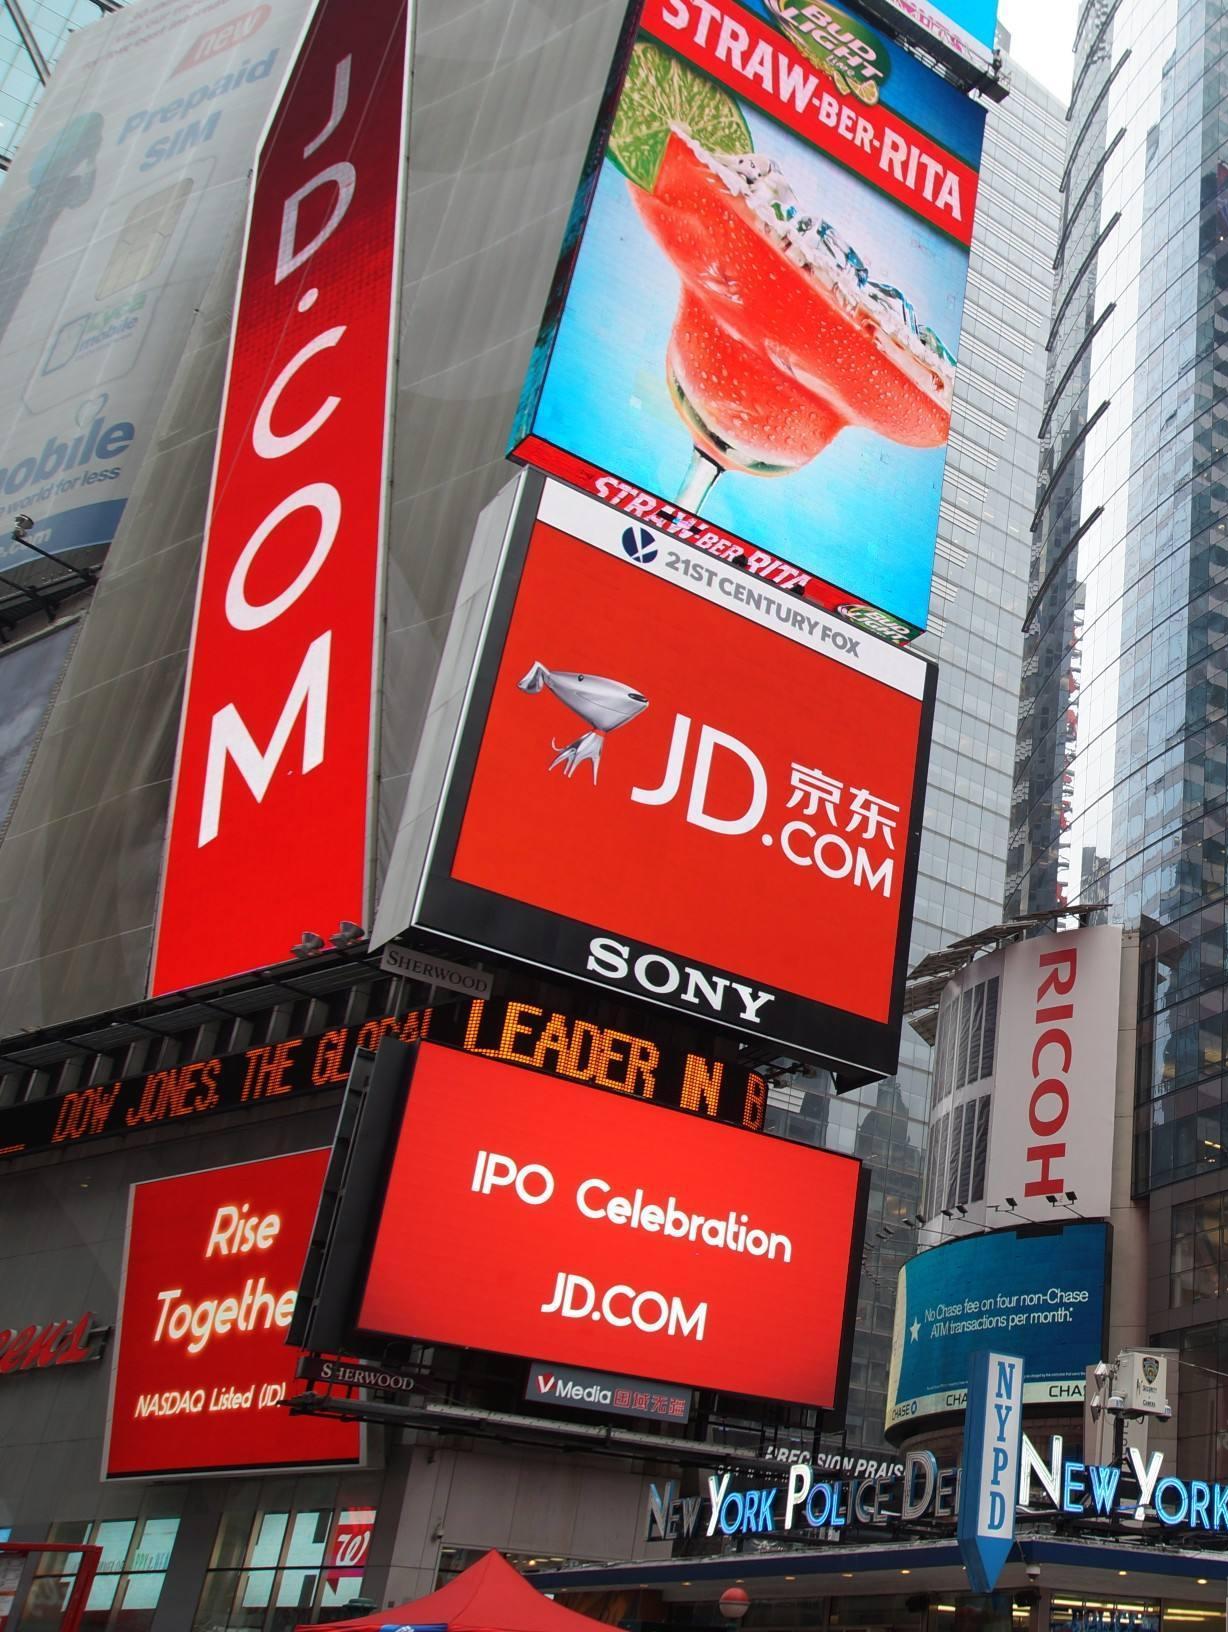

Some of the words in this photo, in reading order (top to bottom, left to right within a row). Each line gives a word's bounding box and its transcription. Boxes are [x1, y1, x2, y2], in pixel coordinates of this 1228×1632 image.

[194, 14, 258, 48] new
[780, 6, 883, 84] LIGHT
[800, 3, 877, 61] BUD
[116, 48, 280, 145] Prepaid
[662, 0, 962, 222] STRAW-BER-RITA
[138, 110, 223, 172] SIM
[55, 478, 80, 495] for
[81, 466, 121, 487] less
[197, 54, 356, 849] JD.COM
[665, 551, 718, 588] 21ST
[718, 577, 823, 636] CENTURY
[821, 626, 862, 658] FOX
[863, 609, 910, 636] BUD
[786, 762, 900, 850] 京东
[385, 949, 488, 995] SHERWOOD
[586, 936, 775, 1024] SONY
[51, 1082, 122, 1143] DOW
[241, 1039, 303, 1102] THE
[463, 998, 660, 1098] LEADER
[679, 1052, 724, 1116] IN
[1024, 947, 1078, 1197] RICOH
[205, 1203, 281, 1258] Rise
[471, 1150, 555, 1205] IPO
[576, 1178, 792, 1263] Celebration
[541, 1271, 708, 1341] JD.COM
[924, 1309, 936, 1322] No
[936, 1303, 963, 1320] Chase
[963, 1298, 979, 1314] fee
[981, 1298, 995, 1311] on
[996, 1293, 1019, 1309] four
[1020, 1288, 1089, 1306] non-Chase
[930, 1323, 950, 1340] ATM
[949, 1314, 1006, 1334] transactions
[1008, 1314, 1026, 1331] per
[134, 1389, 206, 1418] NASDAQ
[209, 1384, 254, 1411] Listed
[321, 1363, 414, 1391] SHERWOOD
[891, 1404, 911, 1421] CHASE
[1048, 1384, 1086, 1398] CHA
[987, 1360, 1015, 1531] NYPD
[1019, 1431, 1122, 1515] NEW
[647, 1481, 701, 1541] NEW
[706, 1472, 778, 1537] YORK
[784, 1463, 896, 1530] POLICE
